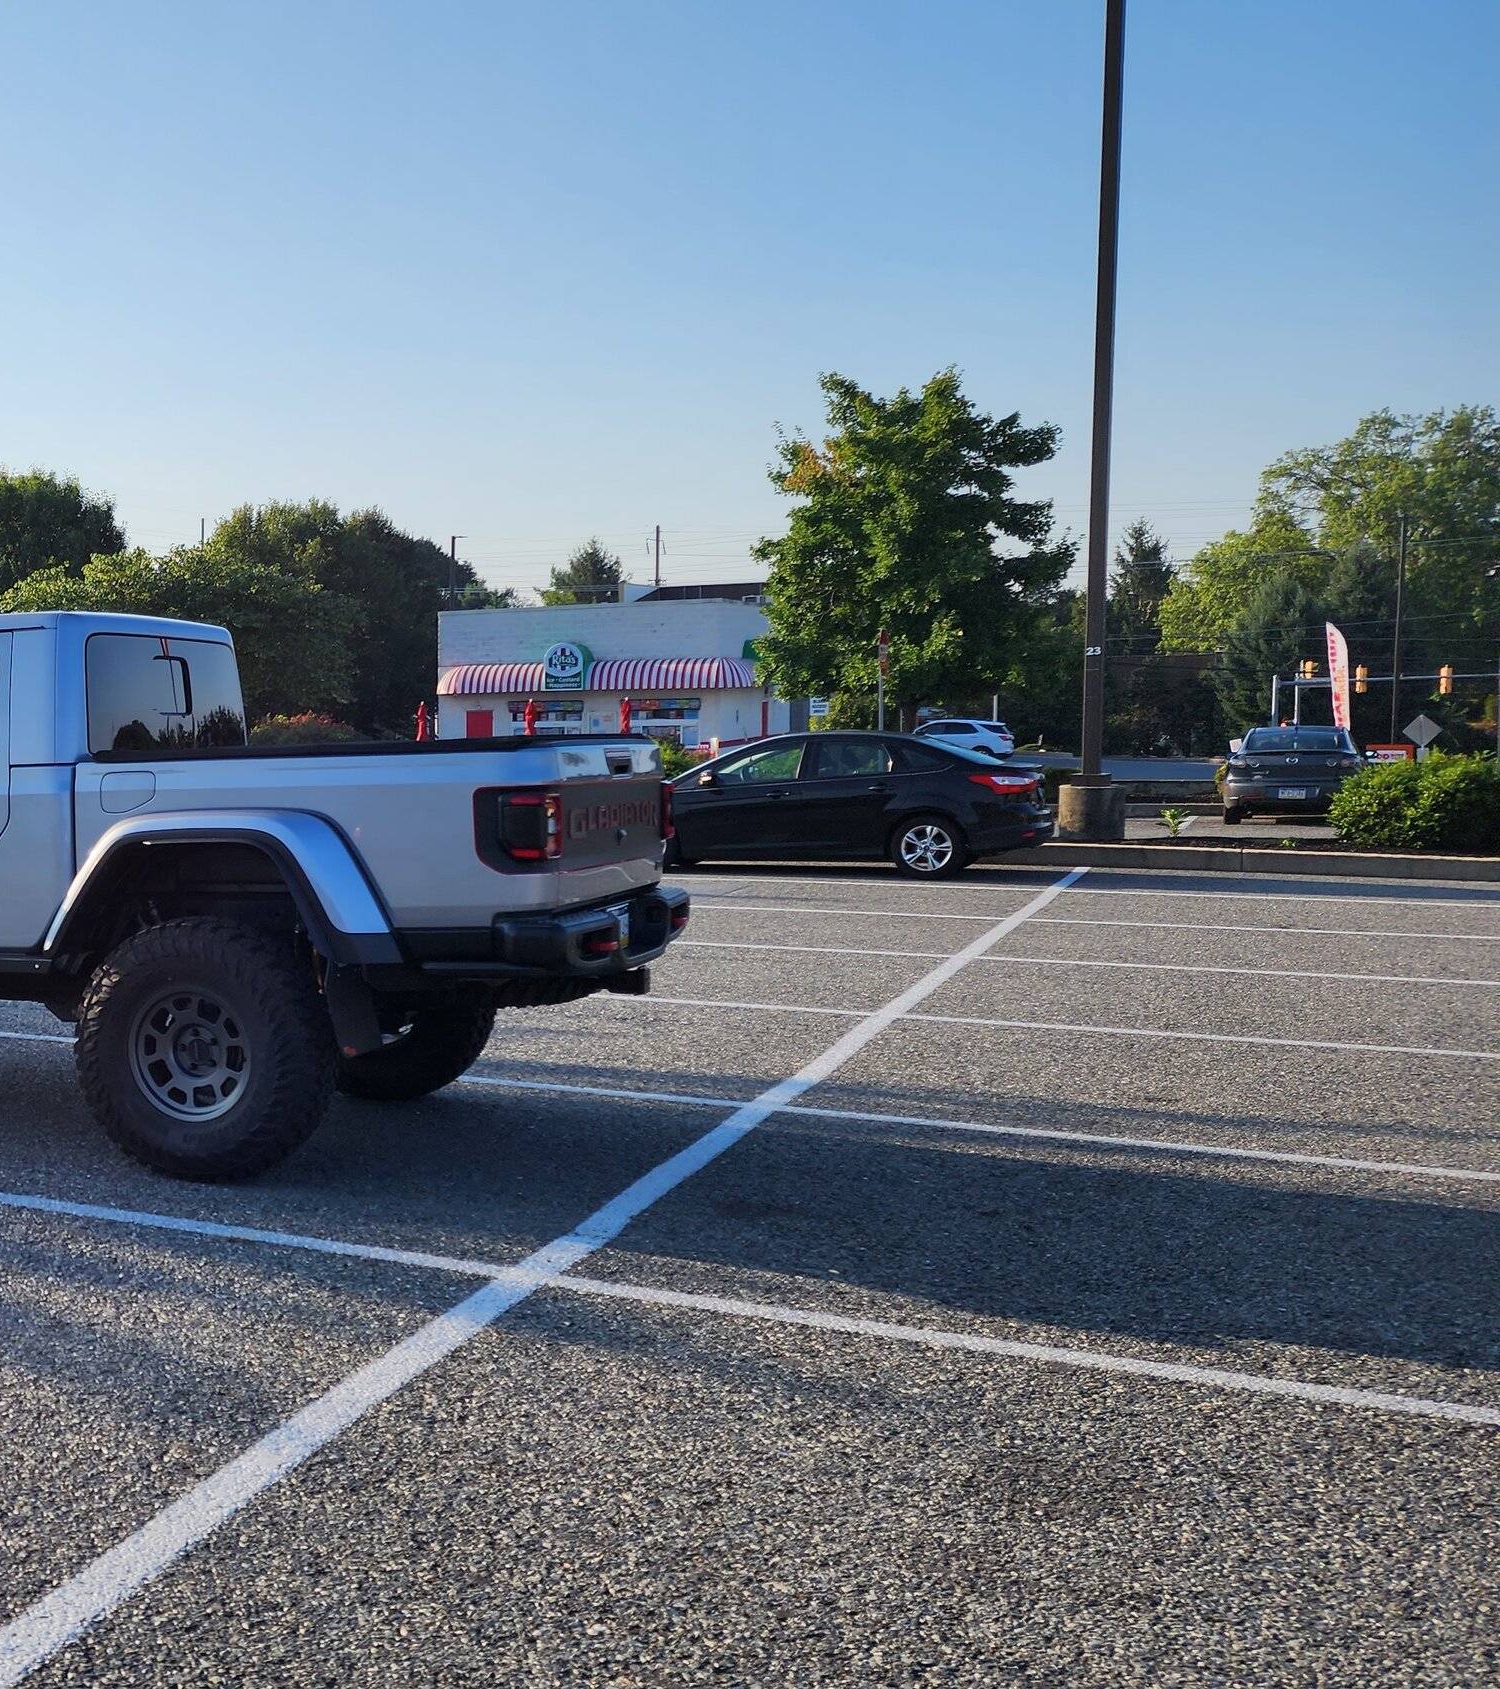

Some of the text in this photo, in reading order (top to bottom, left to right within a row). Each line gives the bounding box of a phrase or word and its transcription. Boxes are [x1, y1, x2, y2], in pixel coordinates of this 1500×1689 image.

[1085, 646, 1101, 656] 23
[552, 655, 576, 666] Rita's
[570, 801, 658, 838] GLADIATOR
